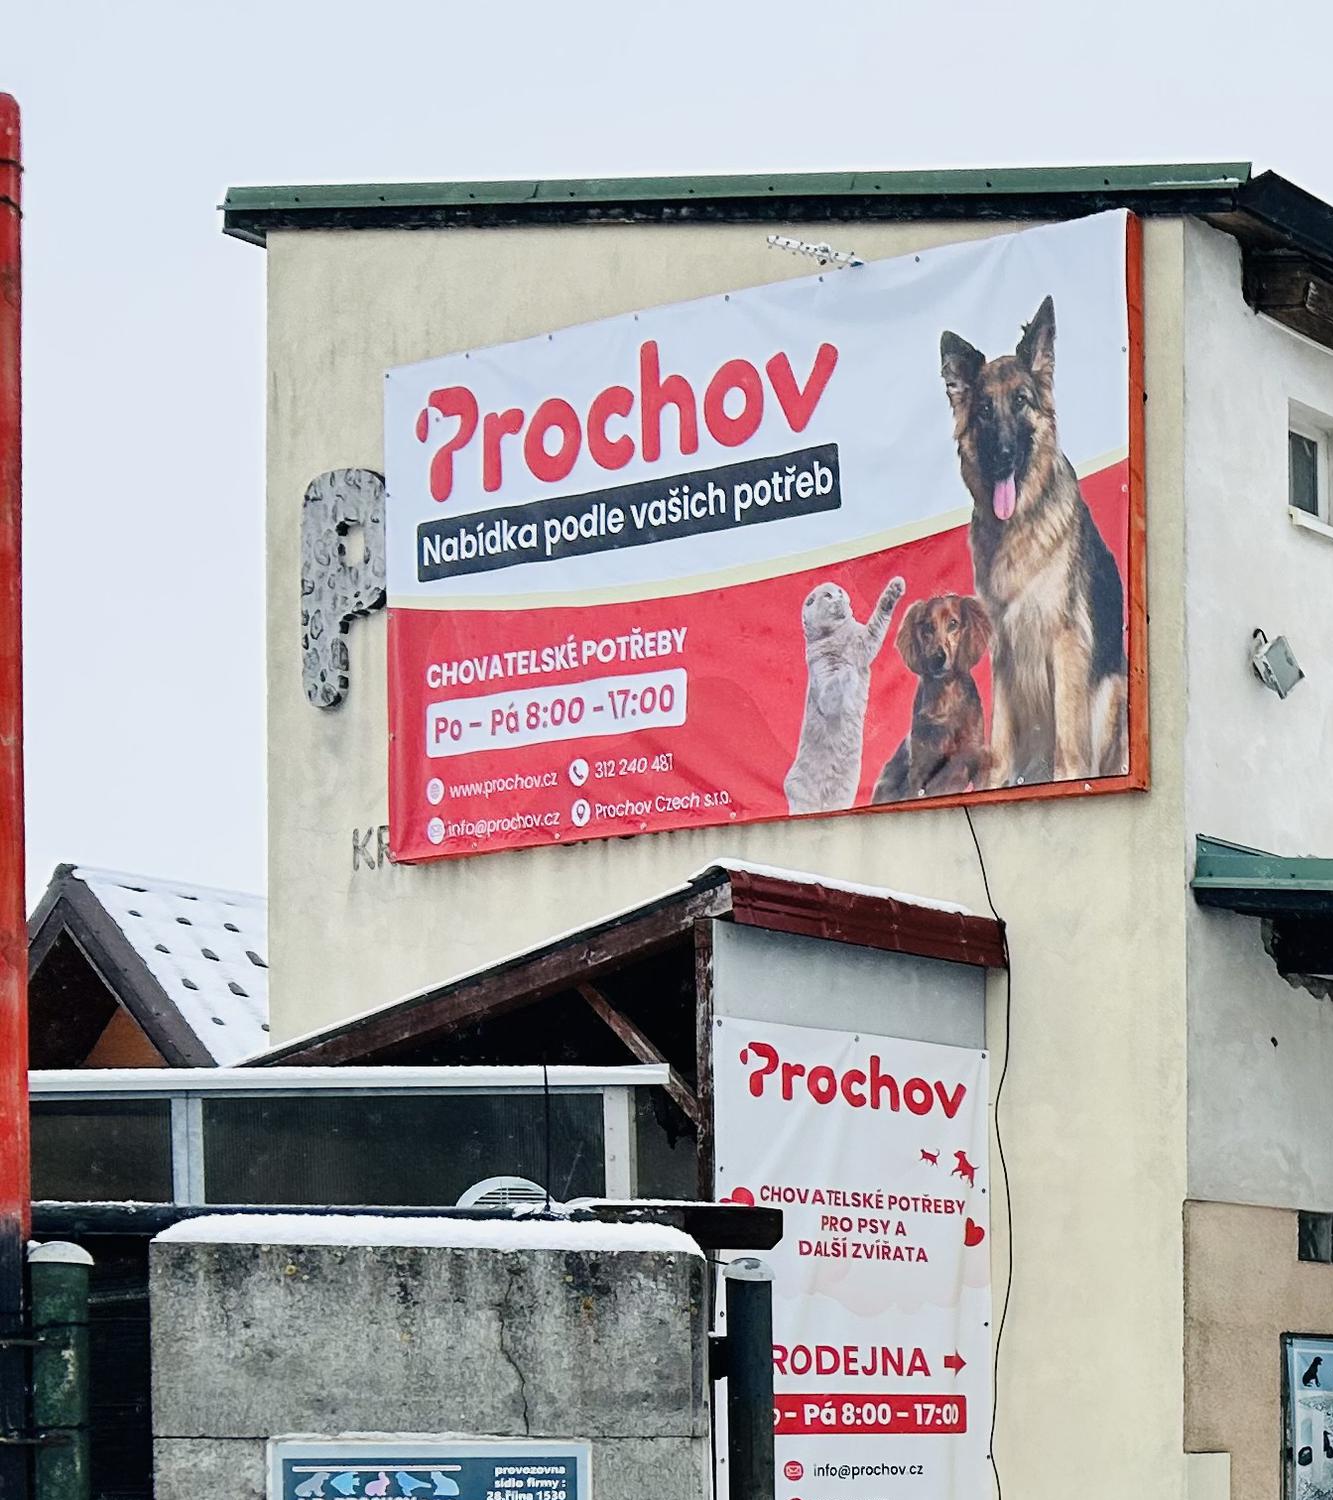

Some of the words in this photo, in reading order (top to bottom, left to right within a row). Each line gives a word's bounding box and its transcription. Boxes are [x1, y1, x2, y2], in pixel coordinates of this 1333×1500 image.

[415, 339, 840, 503] Prochov
[422, 520, 538, 566] Nabídka
[544, 502, 624, 555] podle
[632, 486, 726, 532] vašich
[734, 460, 834, 522] potřeb
[426, 634, 579, 688] CHOVATELSKÉ
[582, 626, 688, 666] POTŘEBY
[434, 716, 462, 744] Po
[491, 702, 520, 736] Pá
[526, 696, 585, 729] 8:00
[608, 684, 675, 719] 17:00
[594, 761, 616, 779] 312
[619, 757, 647, 777] 240
[449, 771, 558, 800] www.prochov.cz
[595, 798, 652, 820] Prochov
[655, 791, 701, 814] Czech
[704, 789, 733, 808] s.r.o.
[448, 810, 561, 839] info@prochov.cz
[739, 1041, 967, 1119] Prochov
[760, 1184, 884, 1210] CHOVATELSKÉ
[888, 1193, 966, 1216] POTŘEBY
[821, 1215, 853, 1233] PRO
[858, 1217, 890, 1236] PSY
[895, 1221, 907, 1237] A
[798, 1235, 848, 1259] DALŠÍ
[852, 1238, 929, 1263] ZVÍŘATA
[773, 1344, 932, 1377] RODEJNA
[803, 1400, 837, 1425] Pá
[841, 1403, 892, 1426] 8:00
[914, 1403, 960, 1426] 17:00
[494, 1466, 566, 1477] provozovna
[494, 1478, 523, 1488] sídlo
[526, 1477, 558, 1489] firmy
[813, 1463, 924, 1480] info@prochov.cz
[535, 1490, 566, 1500] 1530
